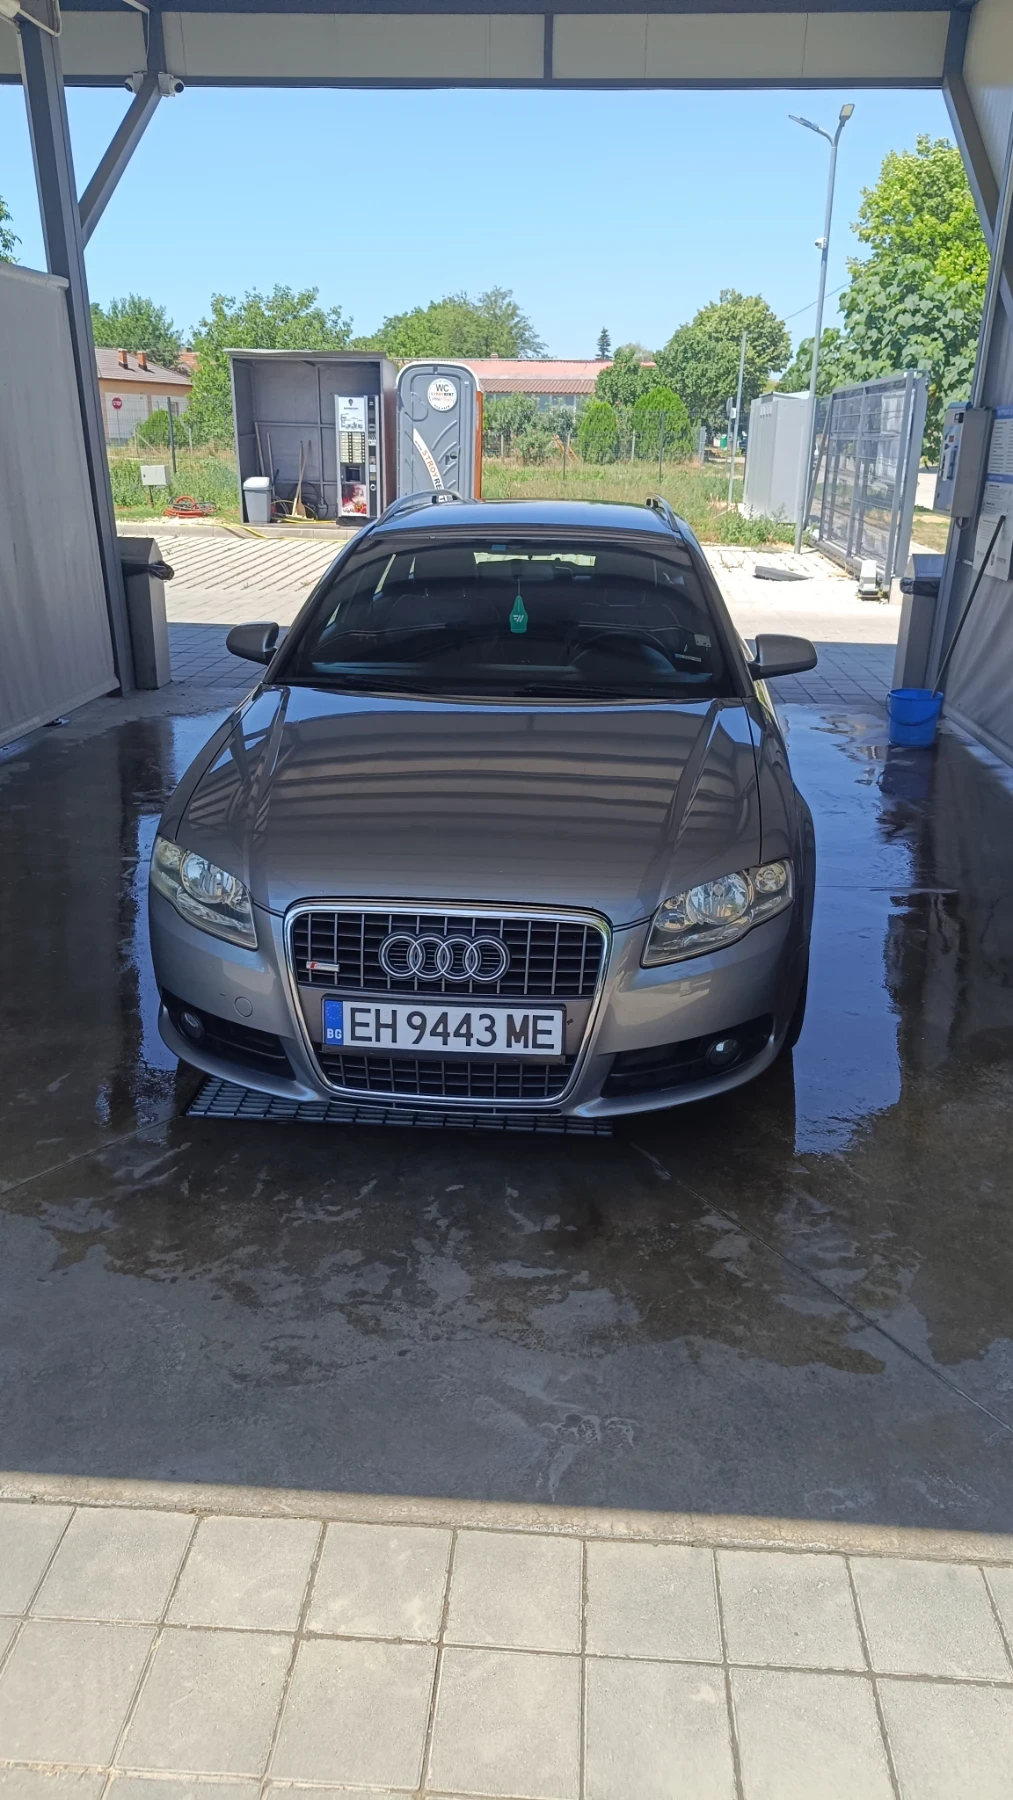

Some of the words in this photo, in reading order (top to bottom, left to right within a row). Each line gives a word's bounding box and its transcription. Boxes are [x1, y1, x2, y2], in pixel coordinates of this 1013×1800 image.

[435, 383, 449, 392] WC
[326, 1028, 342, 1040] BG
[350, 1007, 397, 1043] EH
[406, 1010, 498, 1047] 9443
[506, 1013, 555, 1050] ME
